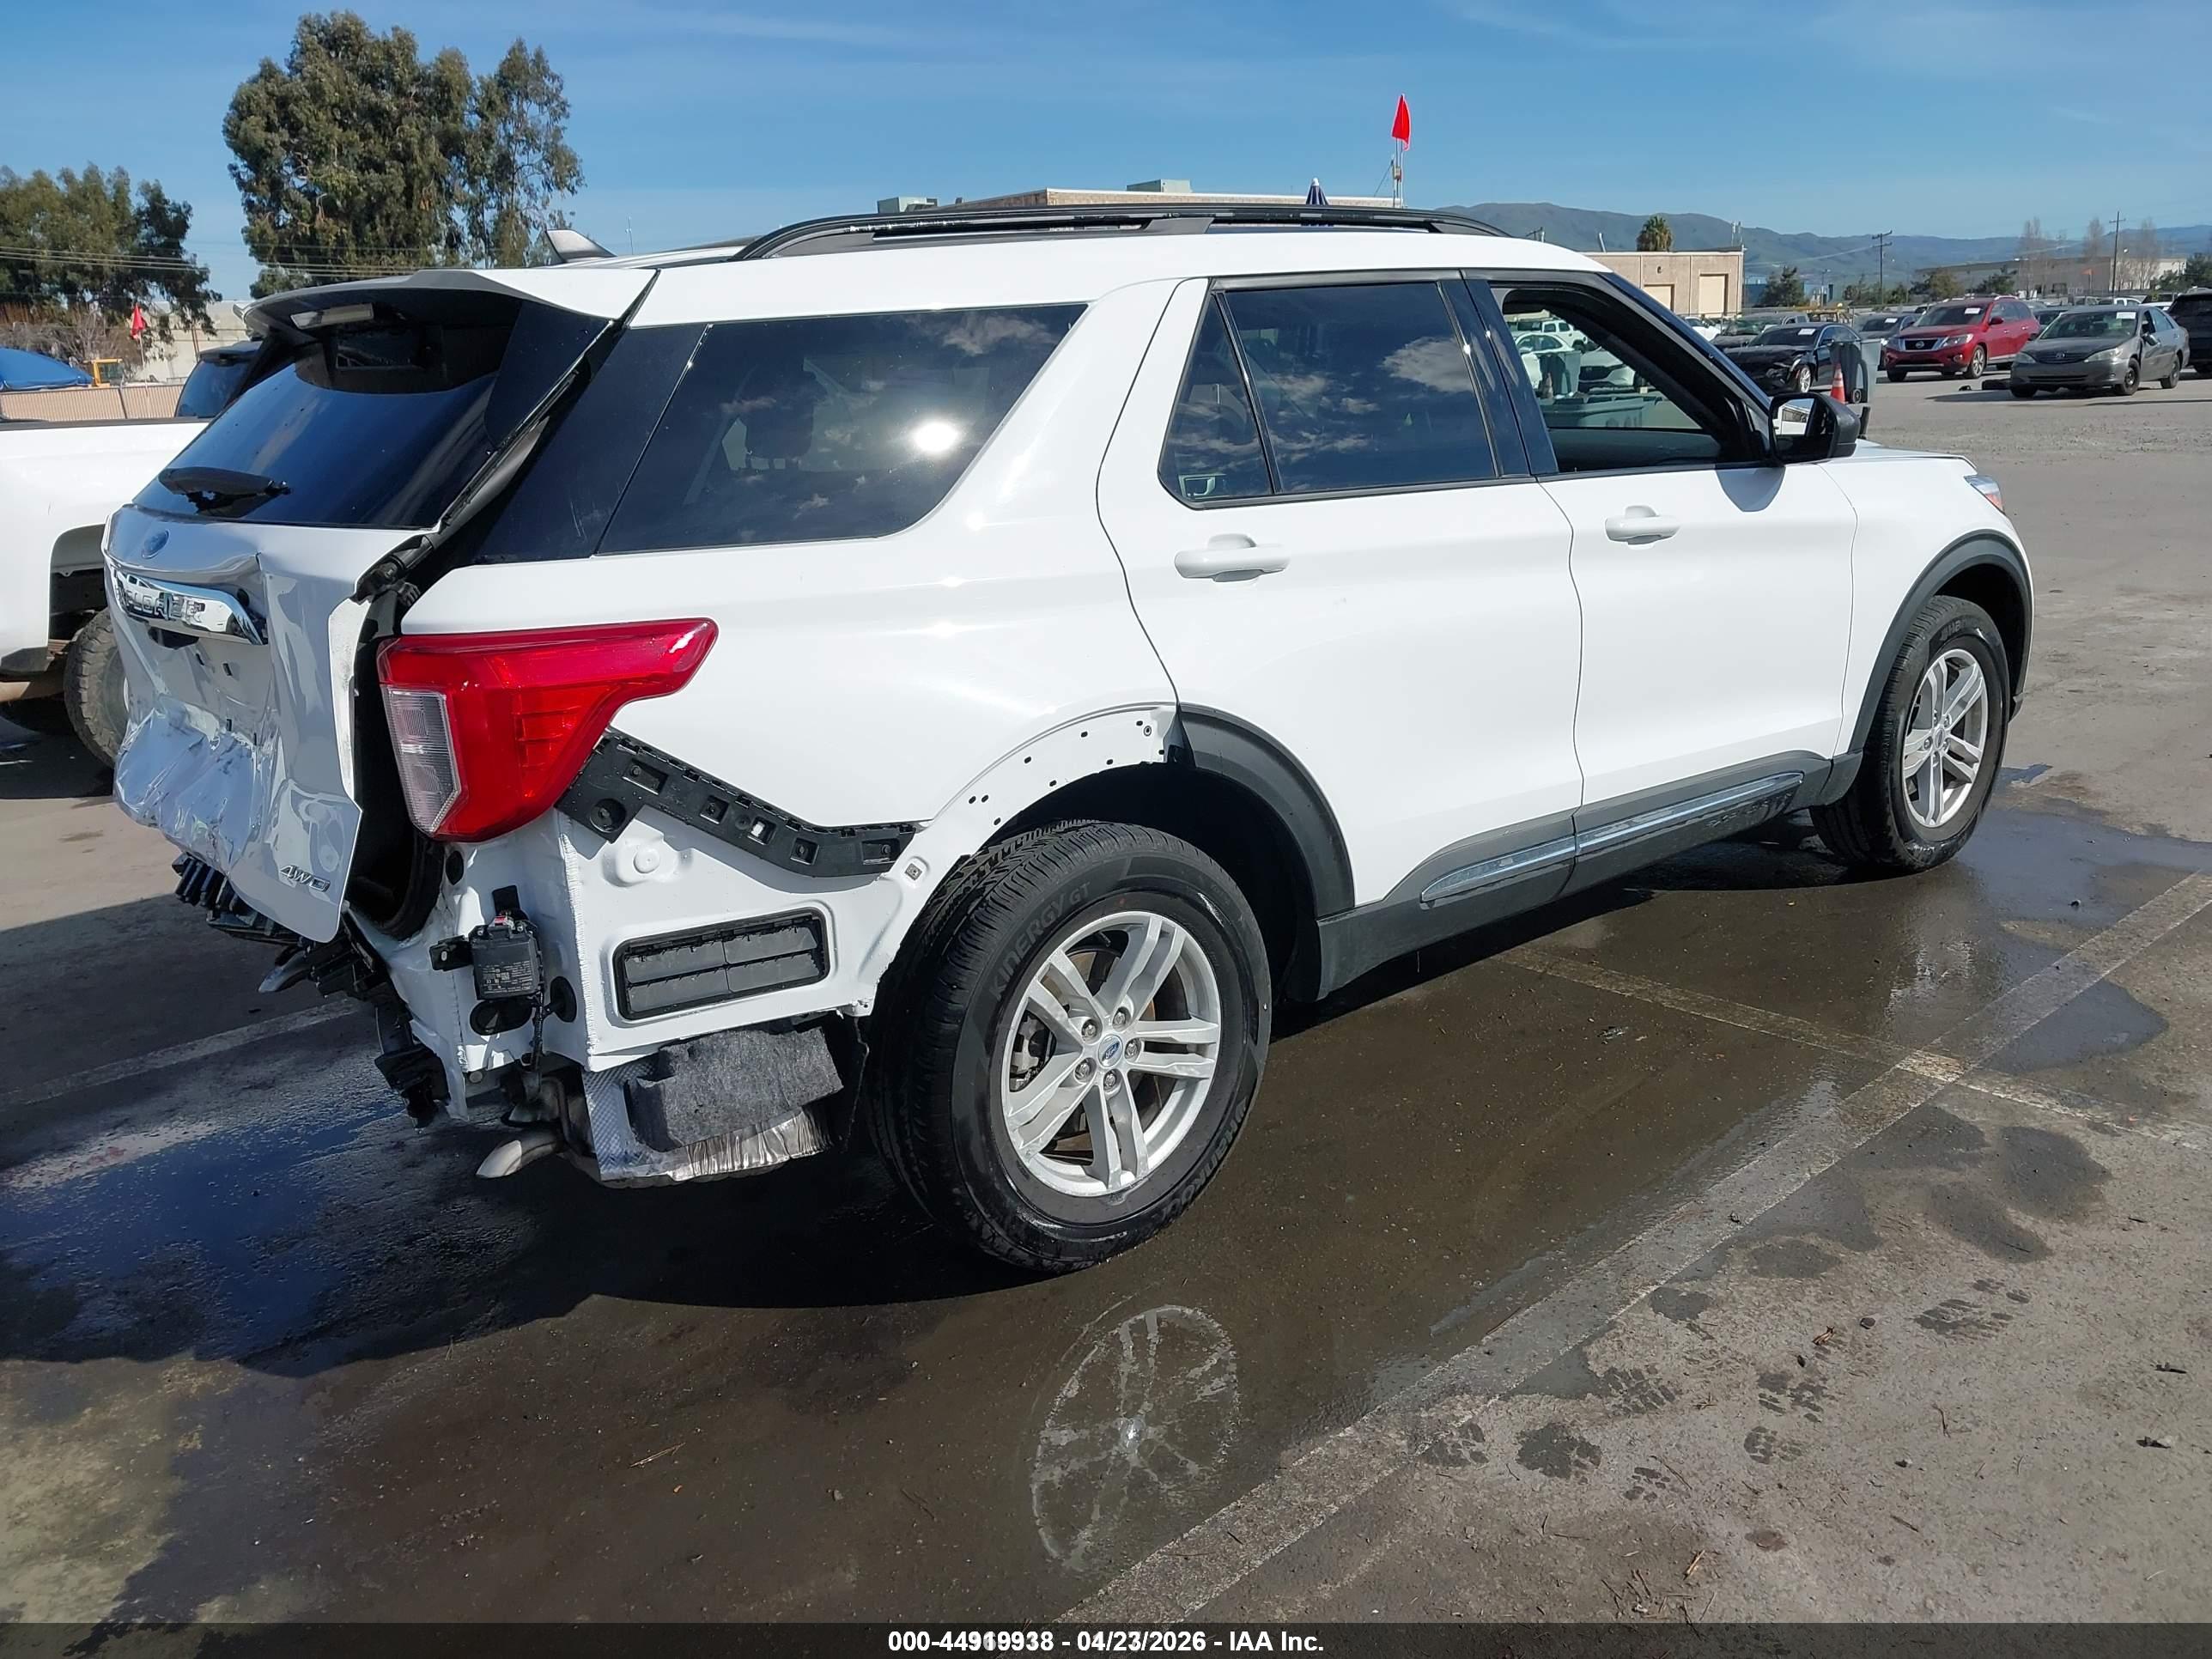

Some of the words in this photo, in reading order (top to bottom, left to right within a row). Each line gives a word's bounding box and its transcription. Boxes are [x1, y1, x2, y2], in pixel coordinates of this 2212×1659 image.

[115, 586, 204, 623] PLORER
[989, 894, 1065, 1002] KINERGY
[1069, 882, 1091, 905] GT
